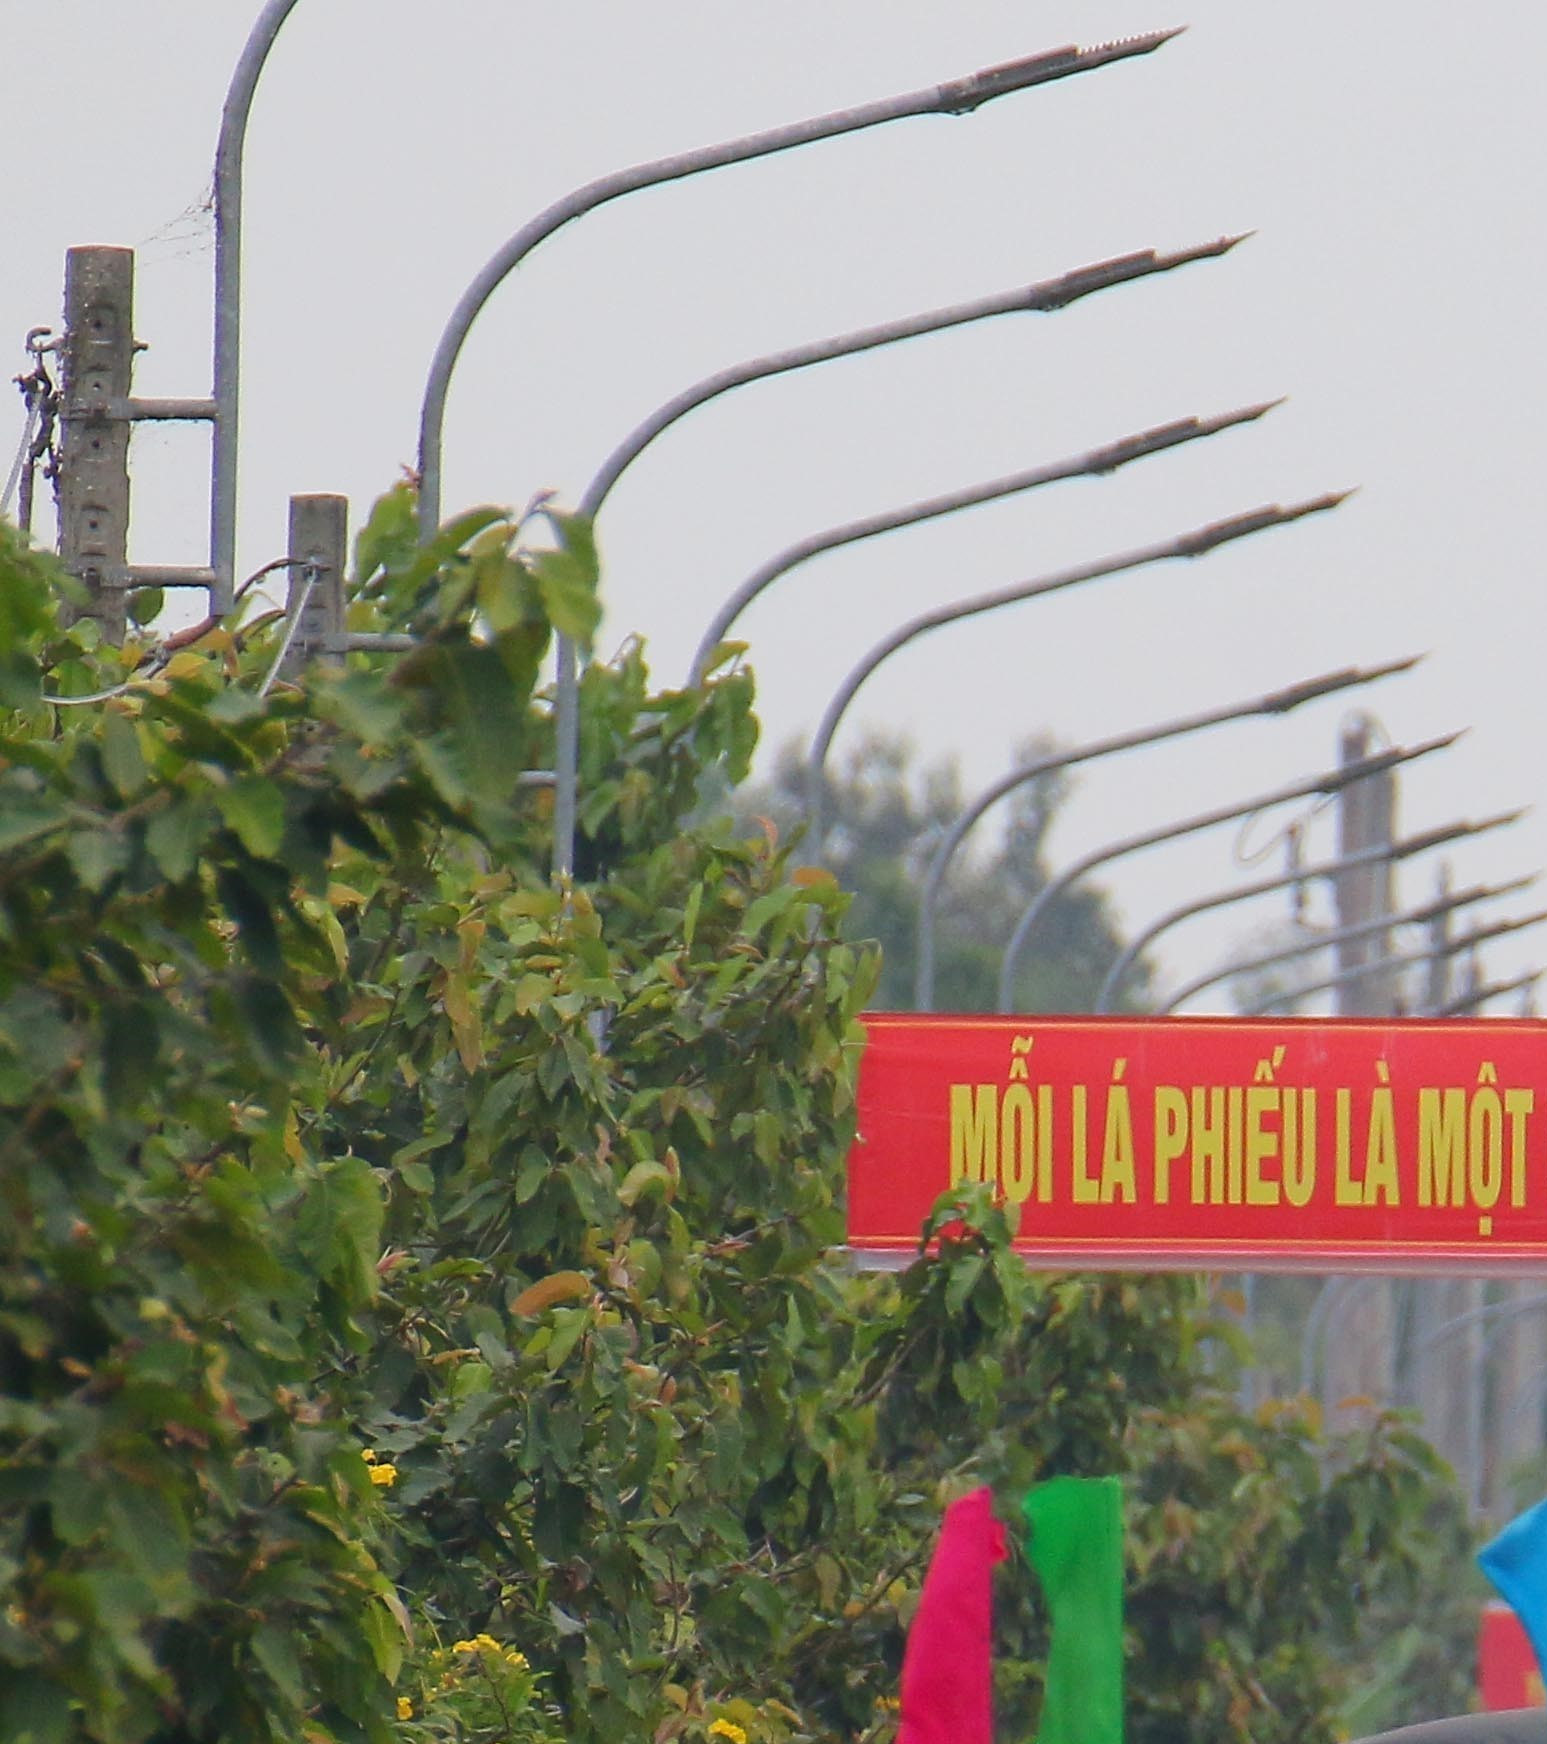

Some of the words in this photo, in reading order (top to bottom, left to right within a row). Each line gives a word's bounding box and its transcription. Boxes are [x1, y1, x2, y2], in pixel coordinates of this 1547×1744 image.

[950, 1035, 1053, 1204] MỖI
[1072, 1058, 1137, 1204] LÁ
[1154, 1046, 1317, 1207] PHIẾU
[1335, 1061, 1400, 1206] LÀ
[1417, 1061, 1534, 1236] MỘT
